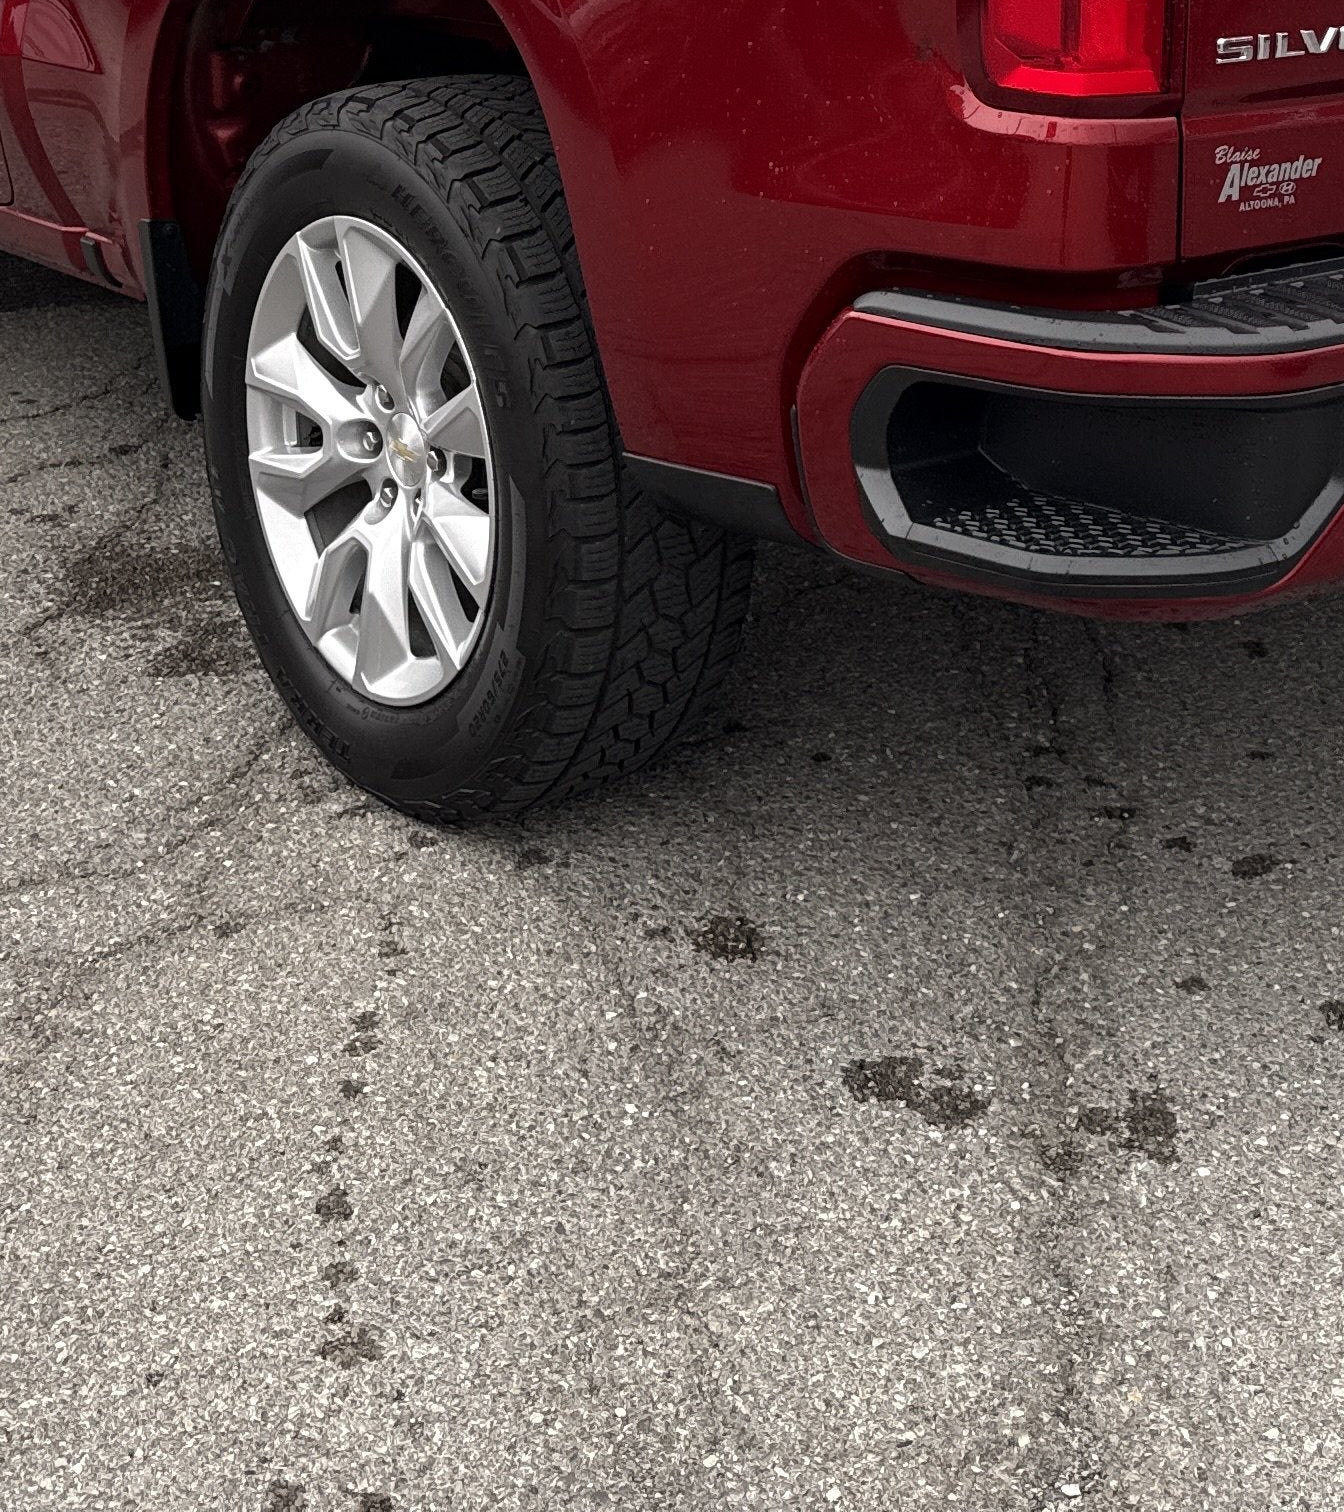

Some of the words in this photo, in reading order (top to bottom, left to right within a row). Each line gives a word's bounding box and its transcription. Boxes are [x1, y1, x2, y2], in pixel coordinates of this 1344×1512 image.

[1214, 144, 1261, 165] Blaise
[1217, 154, 1323, 203] Alexander
[1238, 197, 1283, 212] ALTOONA,
[1283, 194, 1296, 205] PA
